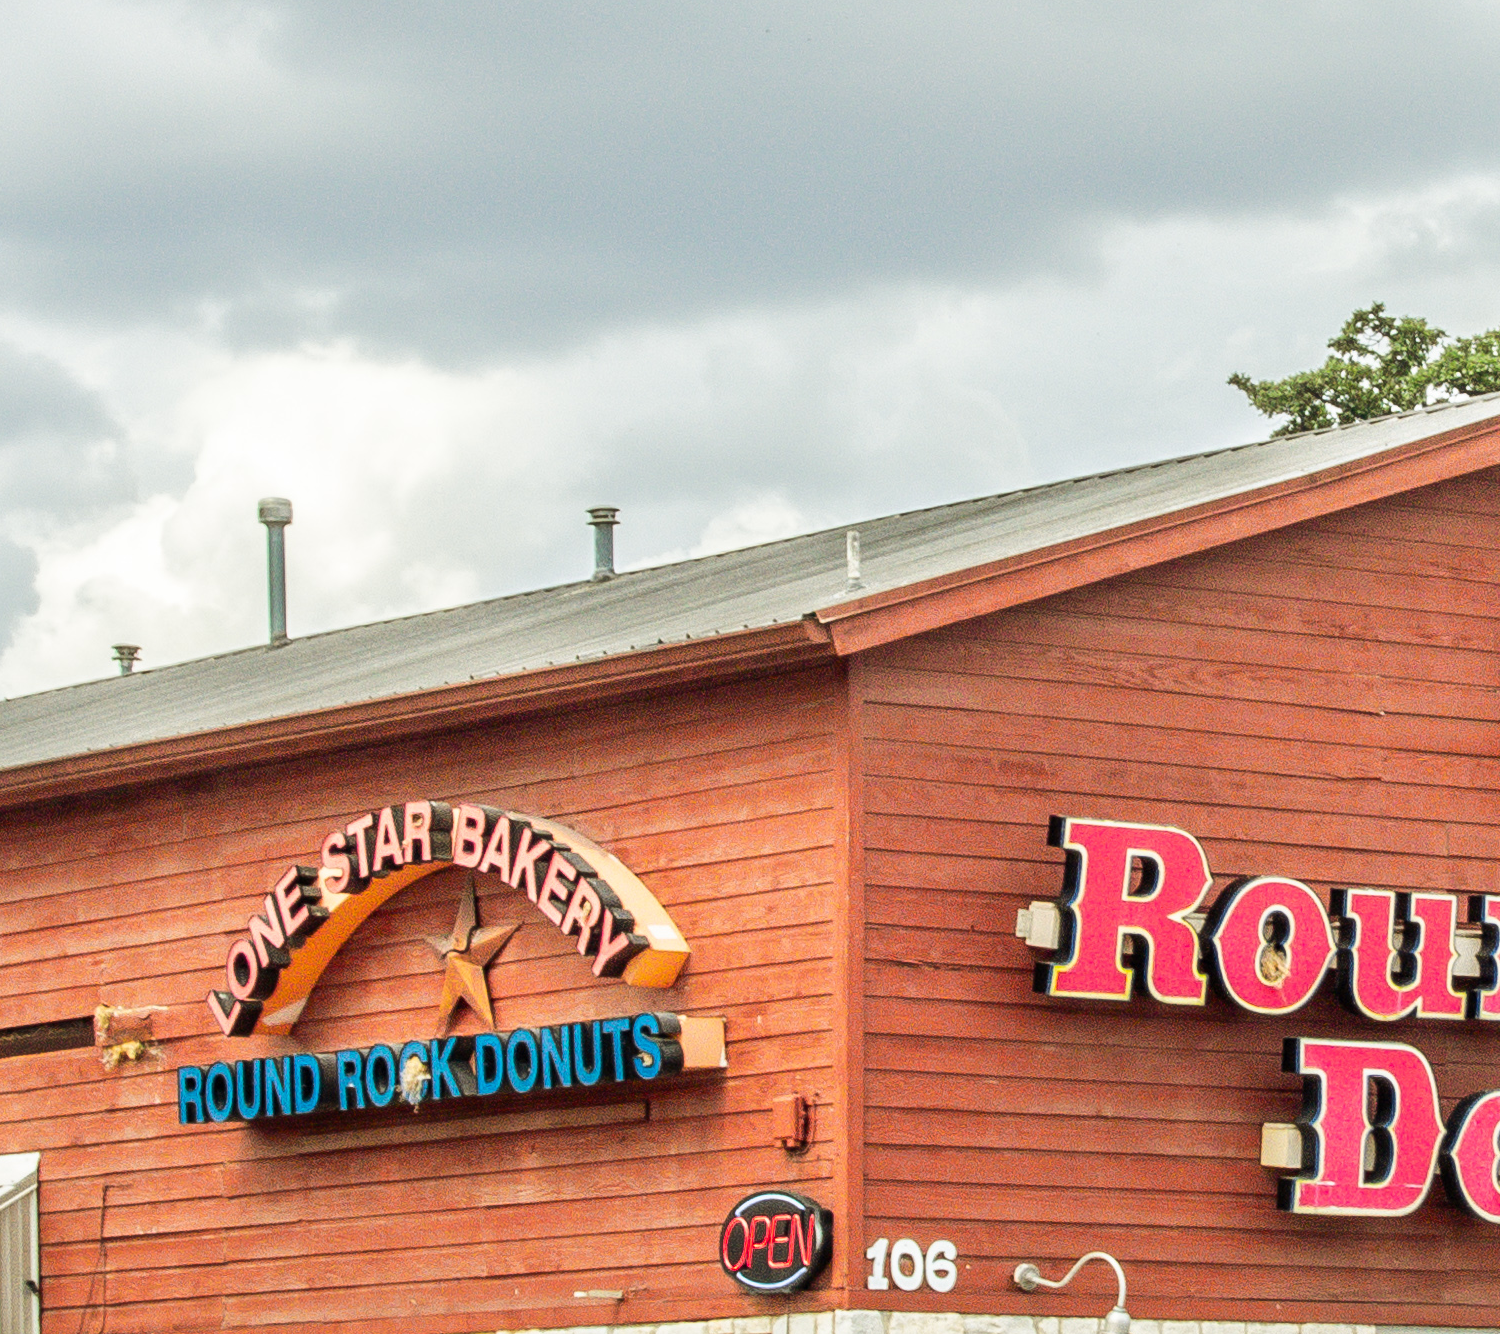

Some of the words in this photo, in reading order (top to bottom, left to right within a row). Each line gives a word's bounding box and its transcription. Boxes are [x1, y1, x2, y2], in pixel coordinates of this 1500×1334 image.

[206, 865, 312, 1037] LONE
[320, 799, 434, 894] STAR
[453, 802, 630, 978] BAKERY
[177, 1052, 322, 1125] ROUND
[336, 1035, 461, 1112] ROCK
[474, 1012, 663, 1095] DONUTS
[722, 1212, 816, 1272] OPEN
[866, 1237, 958, 1293] 106
